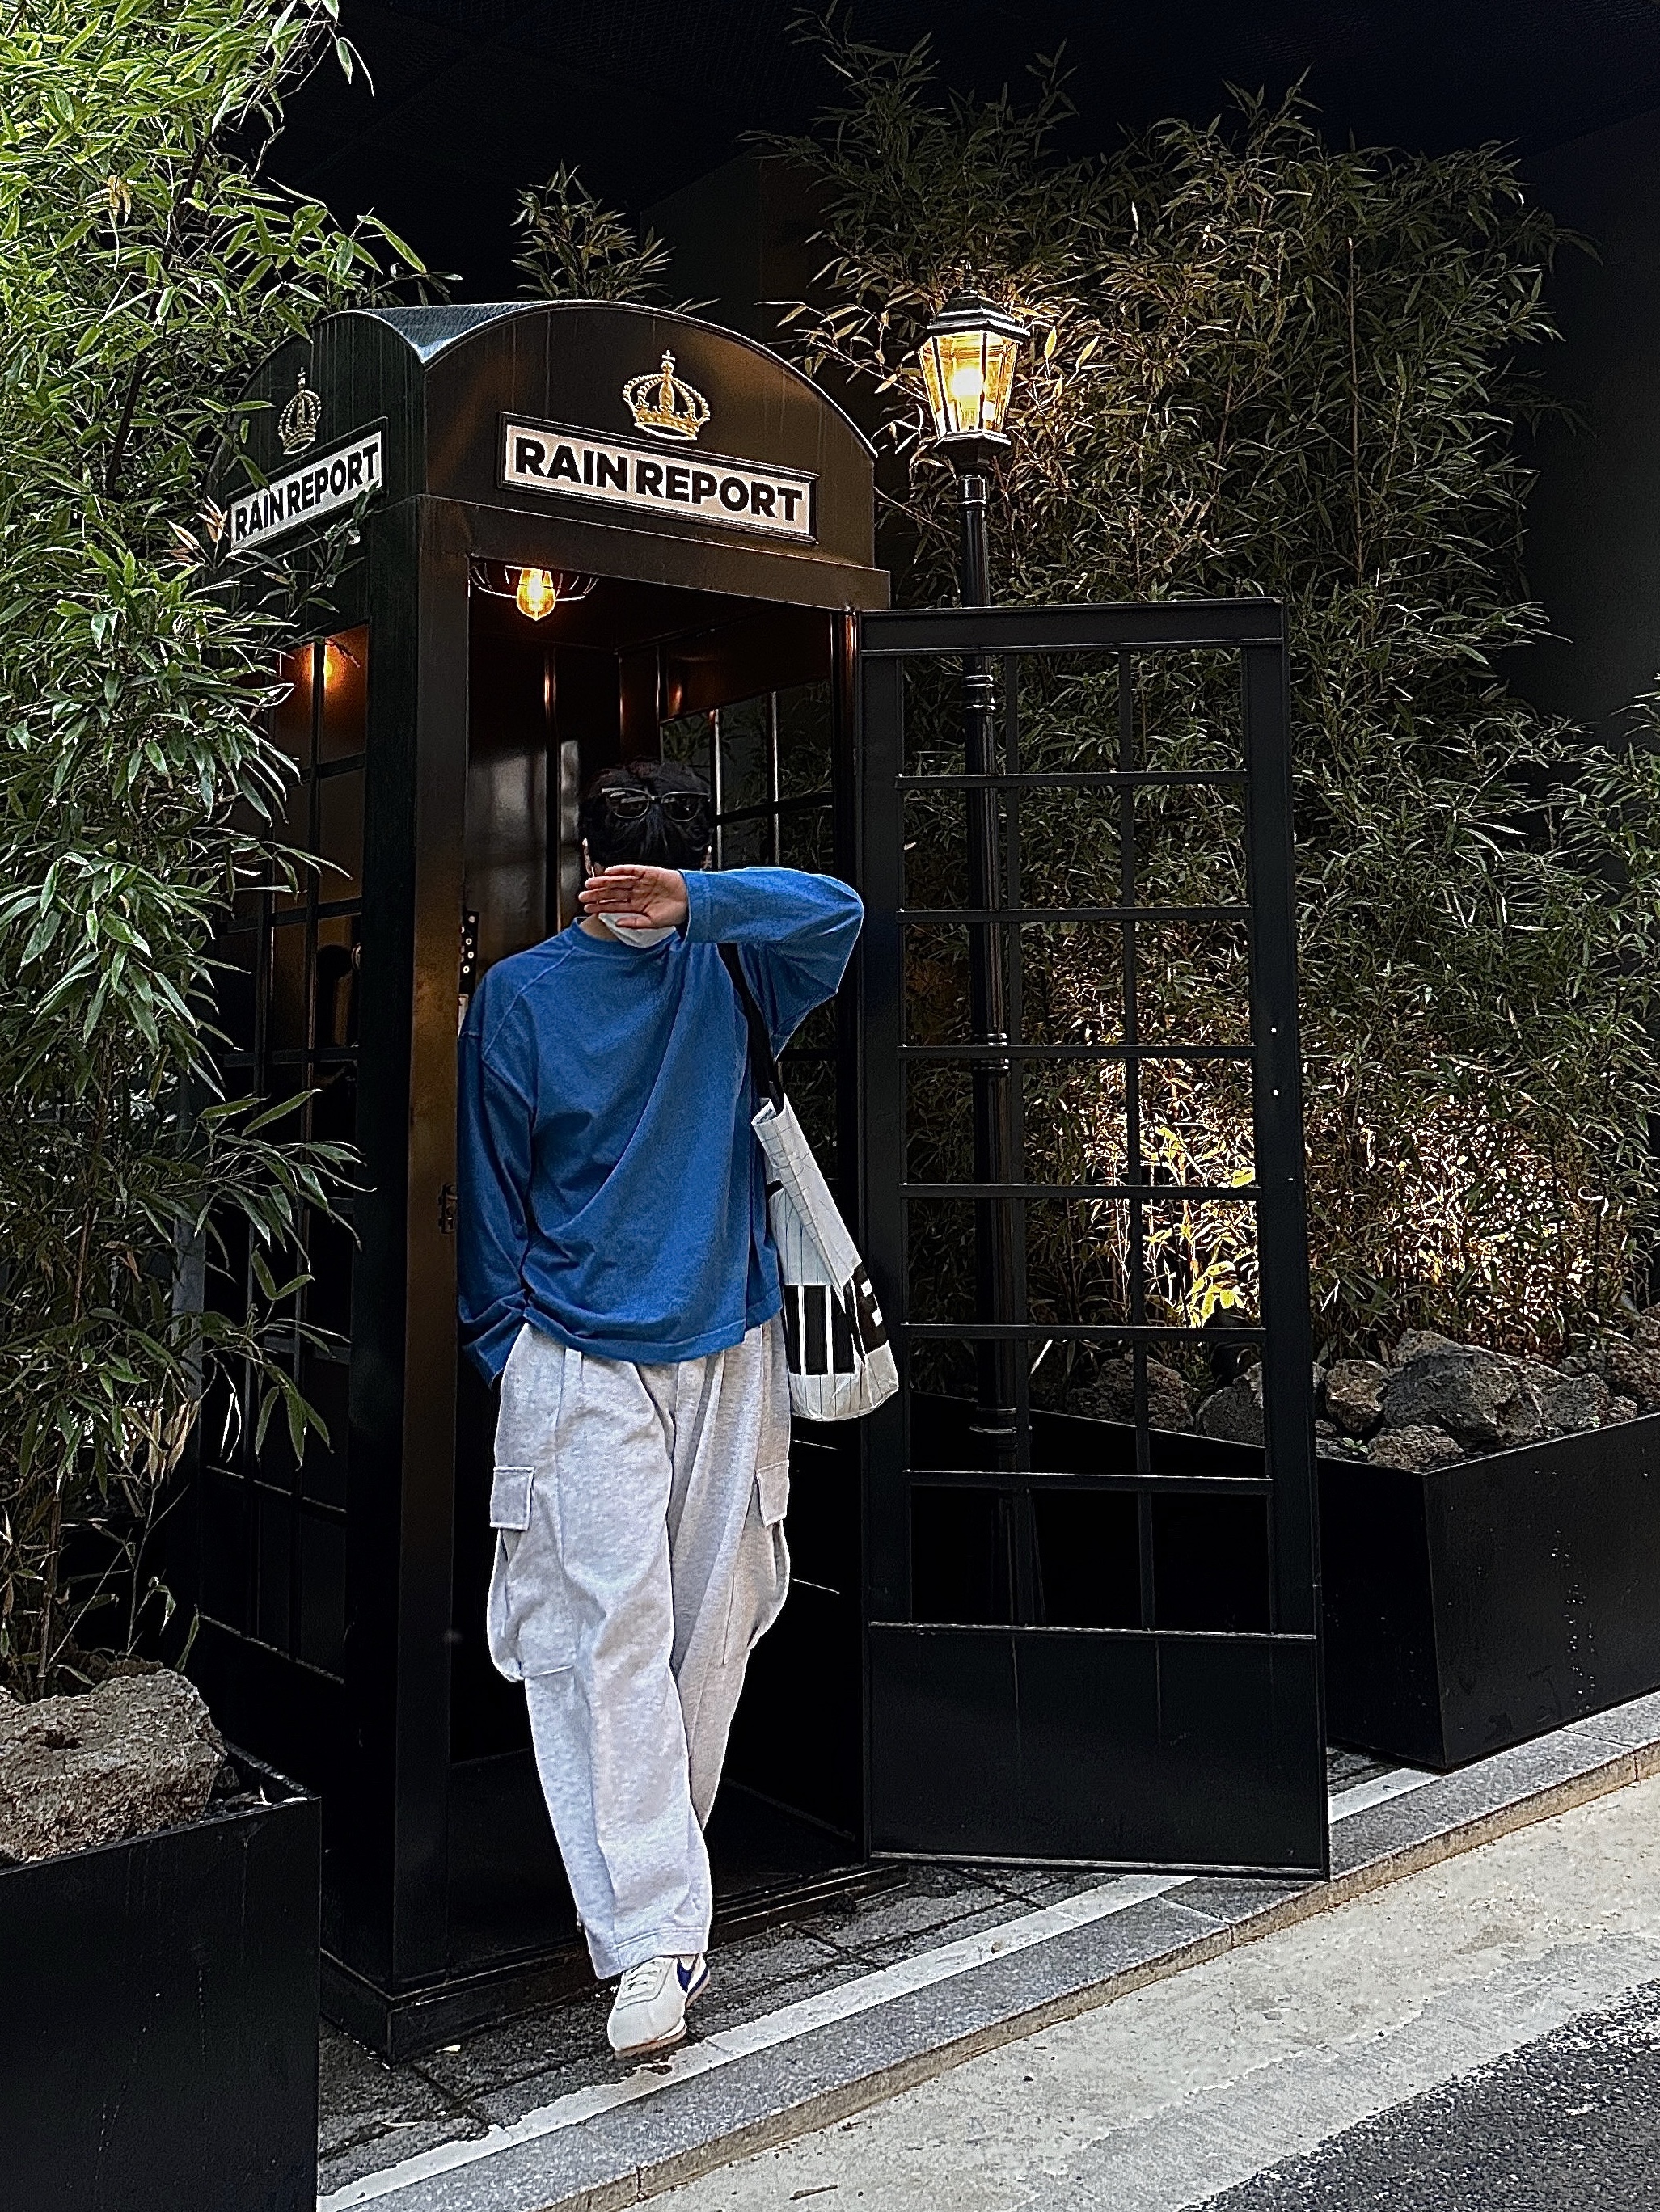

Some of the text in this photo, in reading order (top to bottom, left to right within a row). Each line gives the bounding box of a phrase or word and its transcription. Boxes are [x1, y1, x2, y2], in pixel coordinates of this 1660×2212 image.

[235, 443, 378, 542] RAIN REPORT
[515, 437, 802, 521] RAIN REPORT
